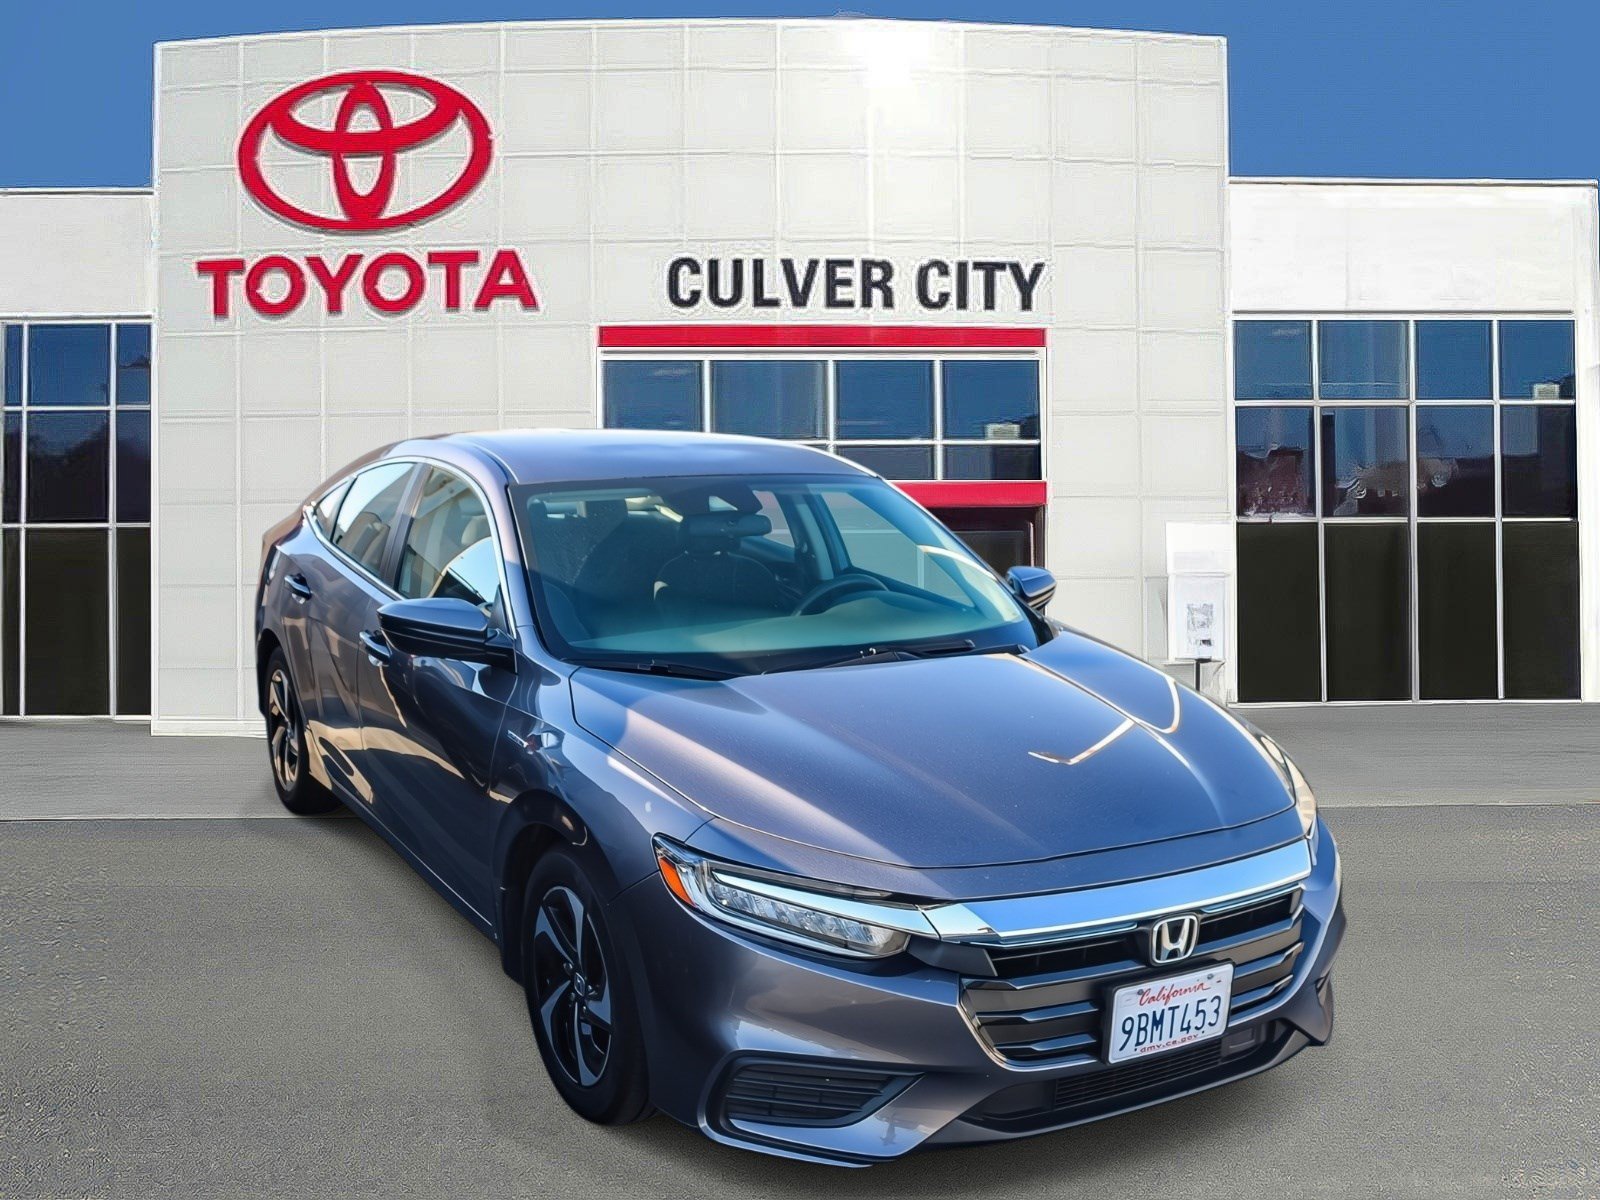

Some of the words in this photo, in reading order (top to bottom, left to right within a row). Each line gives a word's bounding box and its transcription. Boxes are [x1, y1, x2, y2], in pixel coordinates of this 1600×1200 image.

[196, 249, 539, 318] TOYOTA
[667, 257, 895, 310] CULVER
[915, 258, 1046, 312] CITY
[1139, 980, 1211, 1006] California
[1118, 995, 1222, 1052] 9BMT453
[1139, 1033, 1199, 1053] dmv.ca.gov
